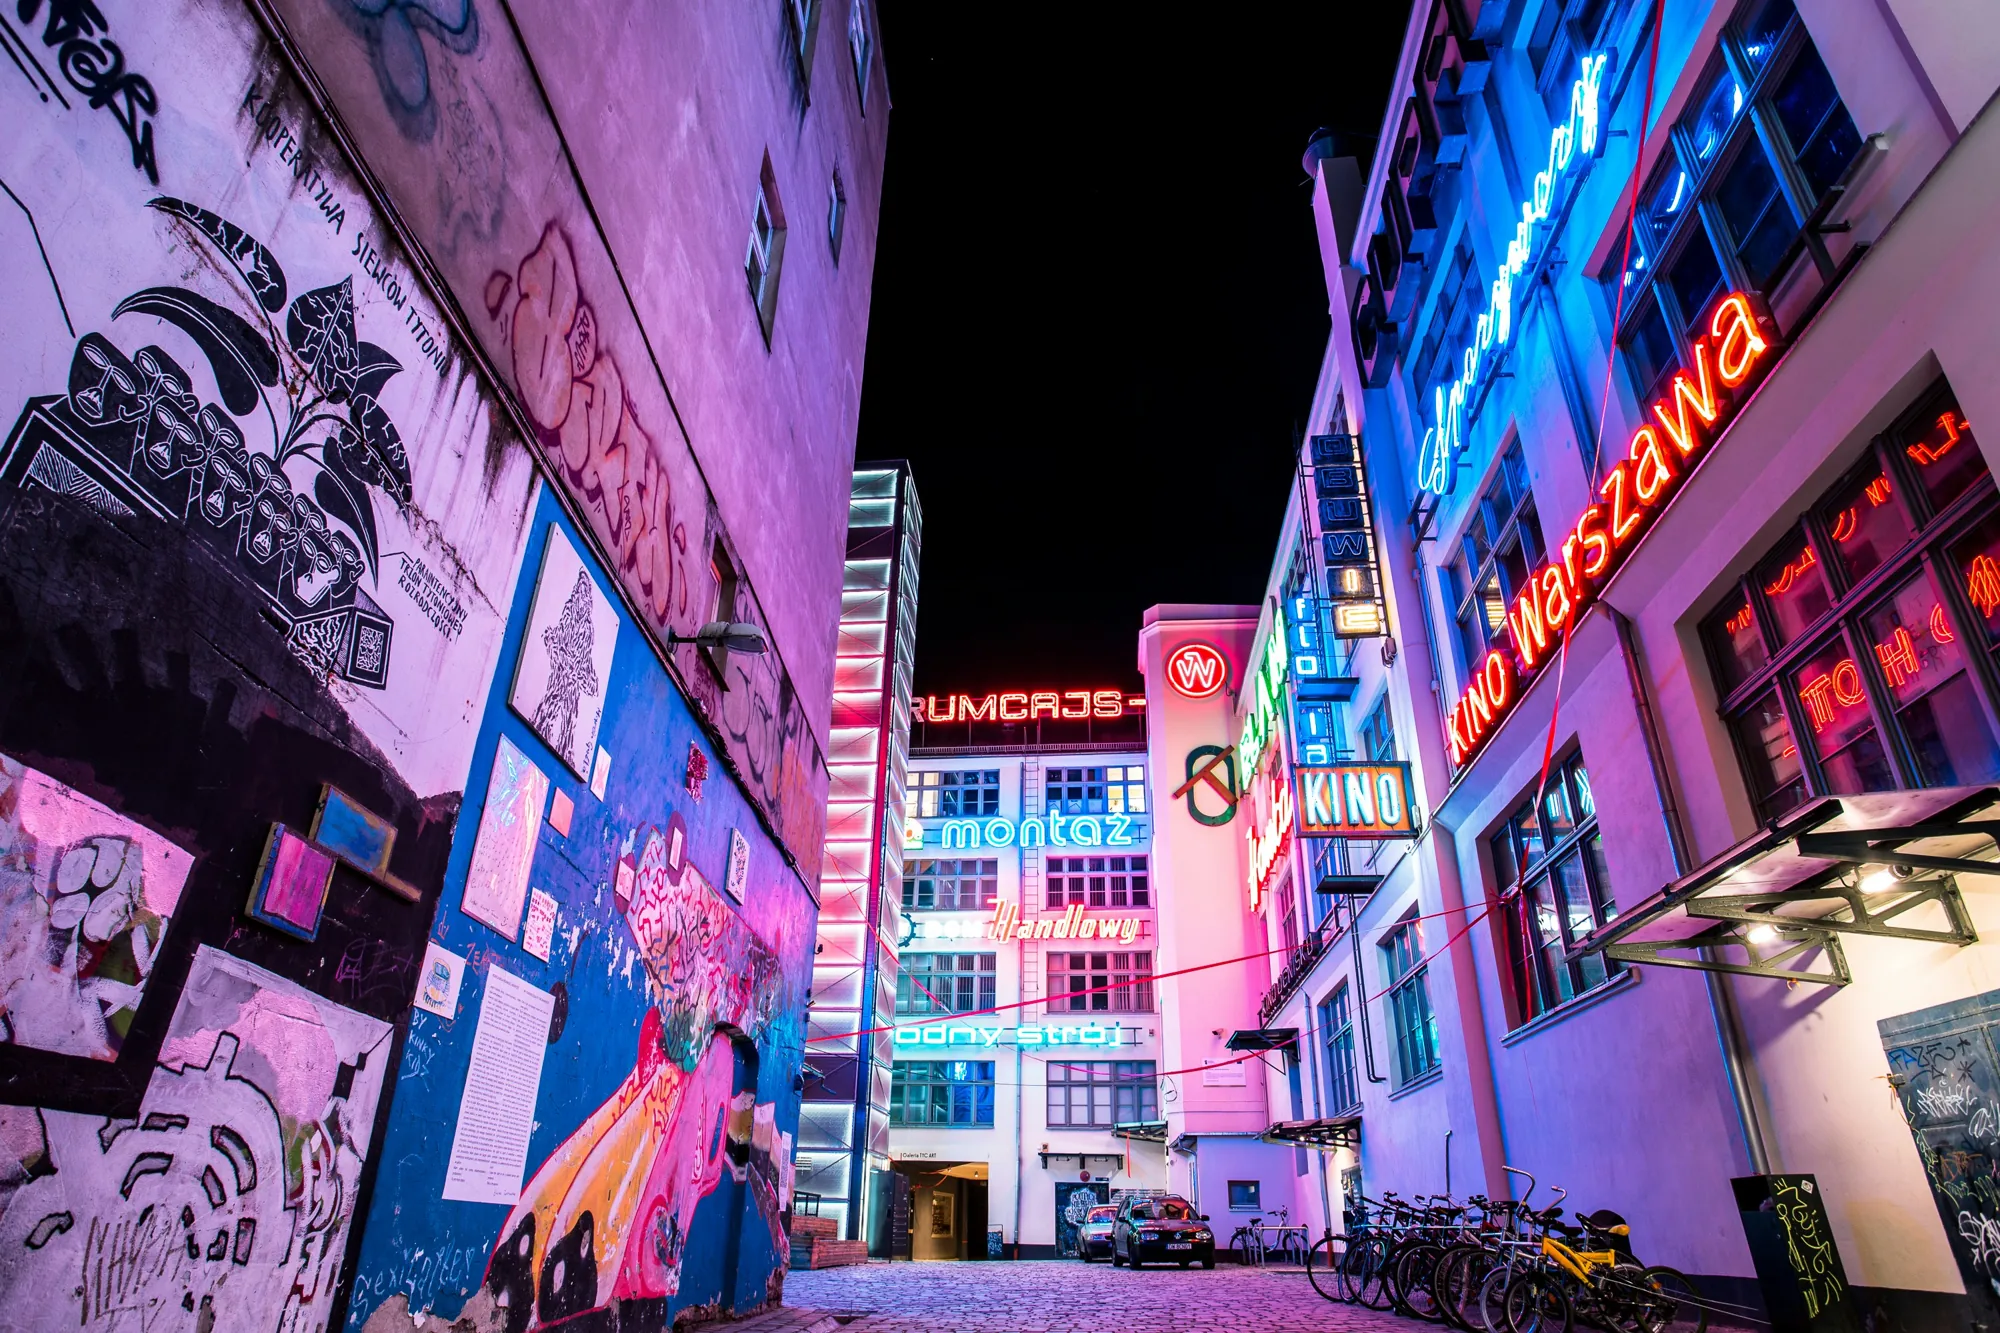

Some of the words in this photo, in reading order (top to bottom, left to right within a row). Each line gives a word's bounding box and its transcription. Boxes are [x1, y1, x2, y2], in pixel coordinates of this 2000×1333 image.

[1315, 435, 1381, 632] OBUWIE
[1446, 648, 1507, 765] KINO
[1508, 292, 1767, 668] Warszawa
[1303, 770, 1401, 827] KINO
[985, 898, 1140, 945] Handlowy
[894, 1023, 1003, 1048] odny
